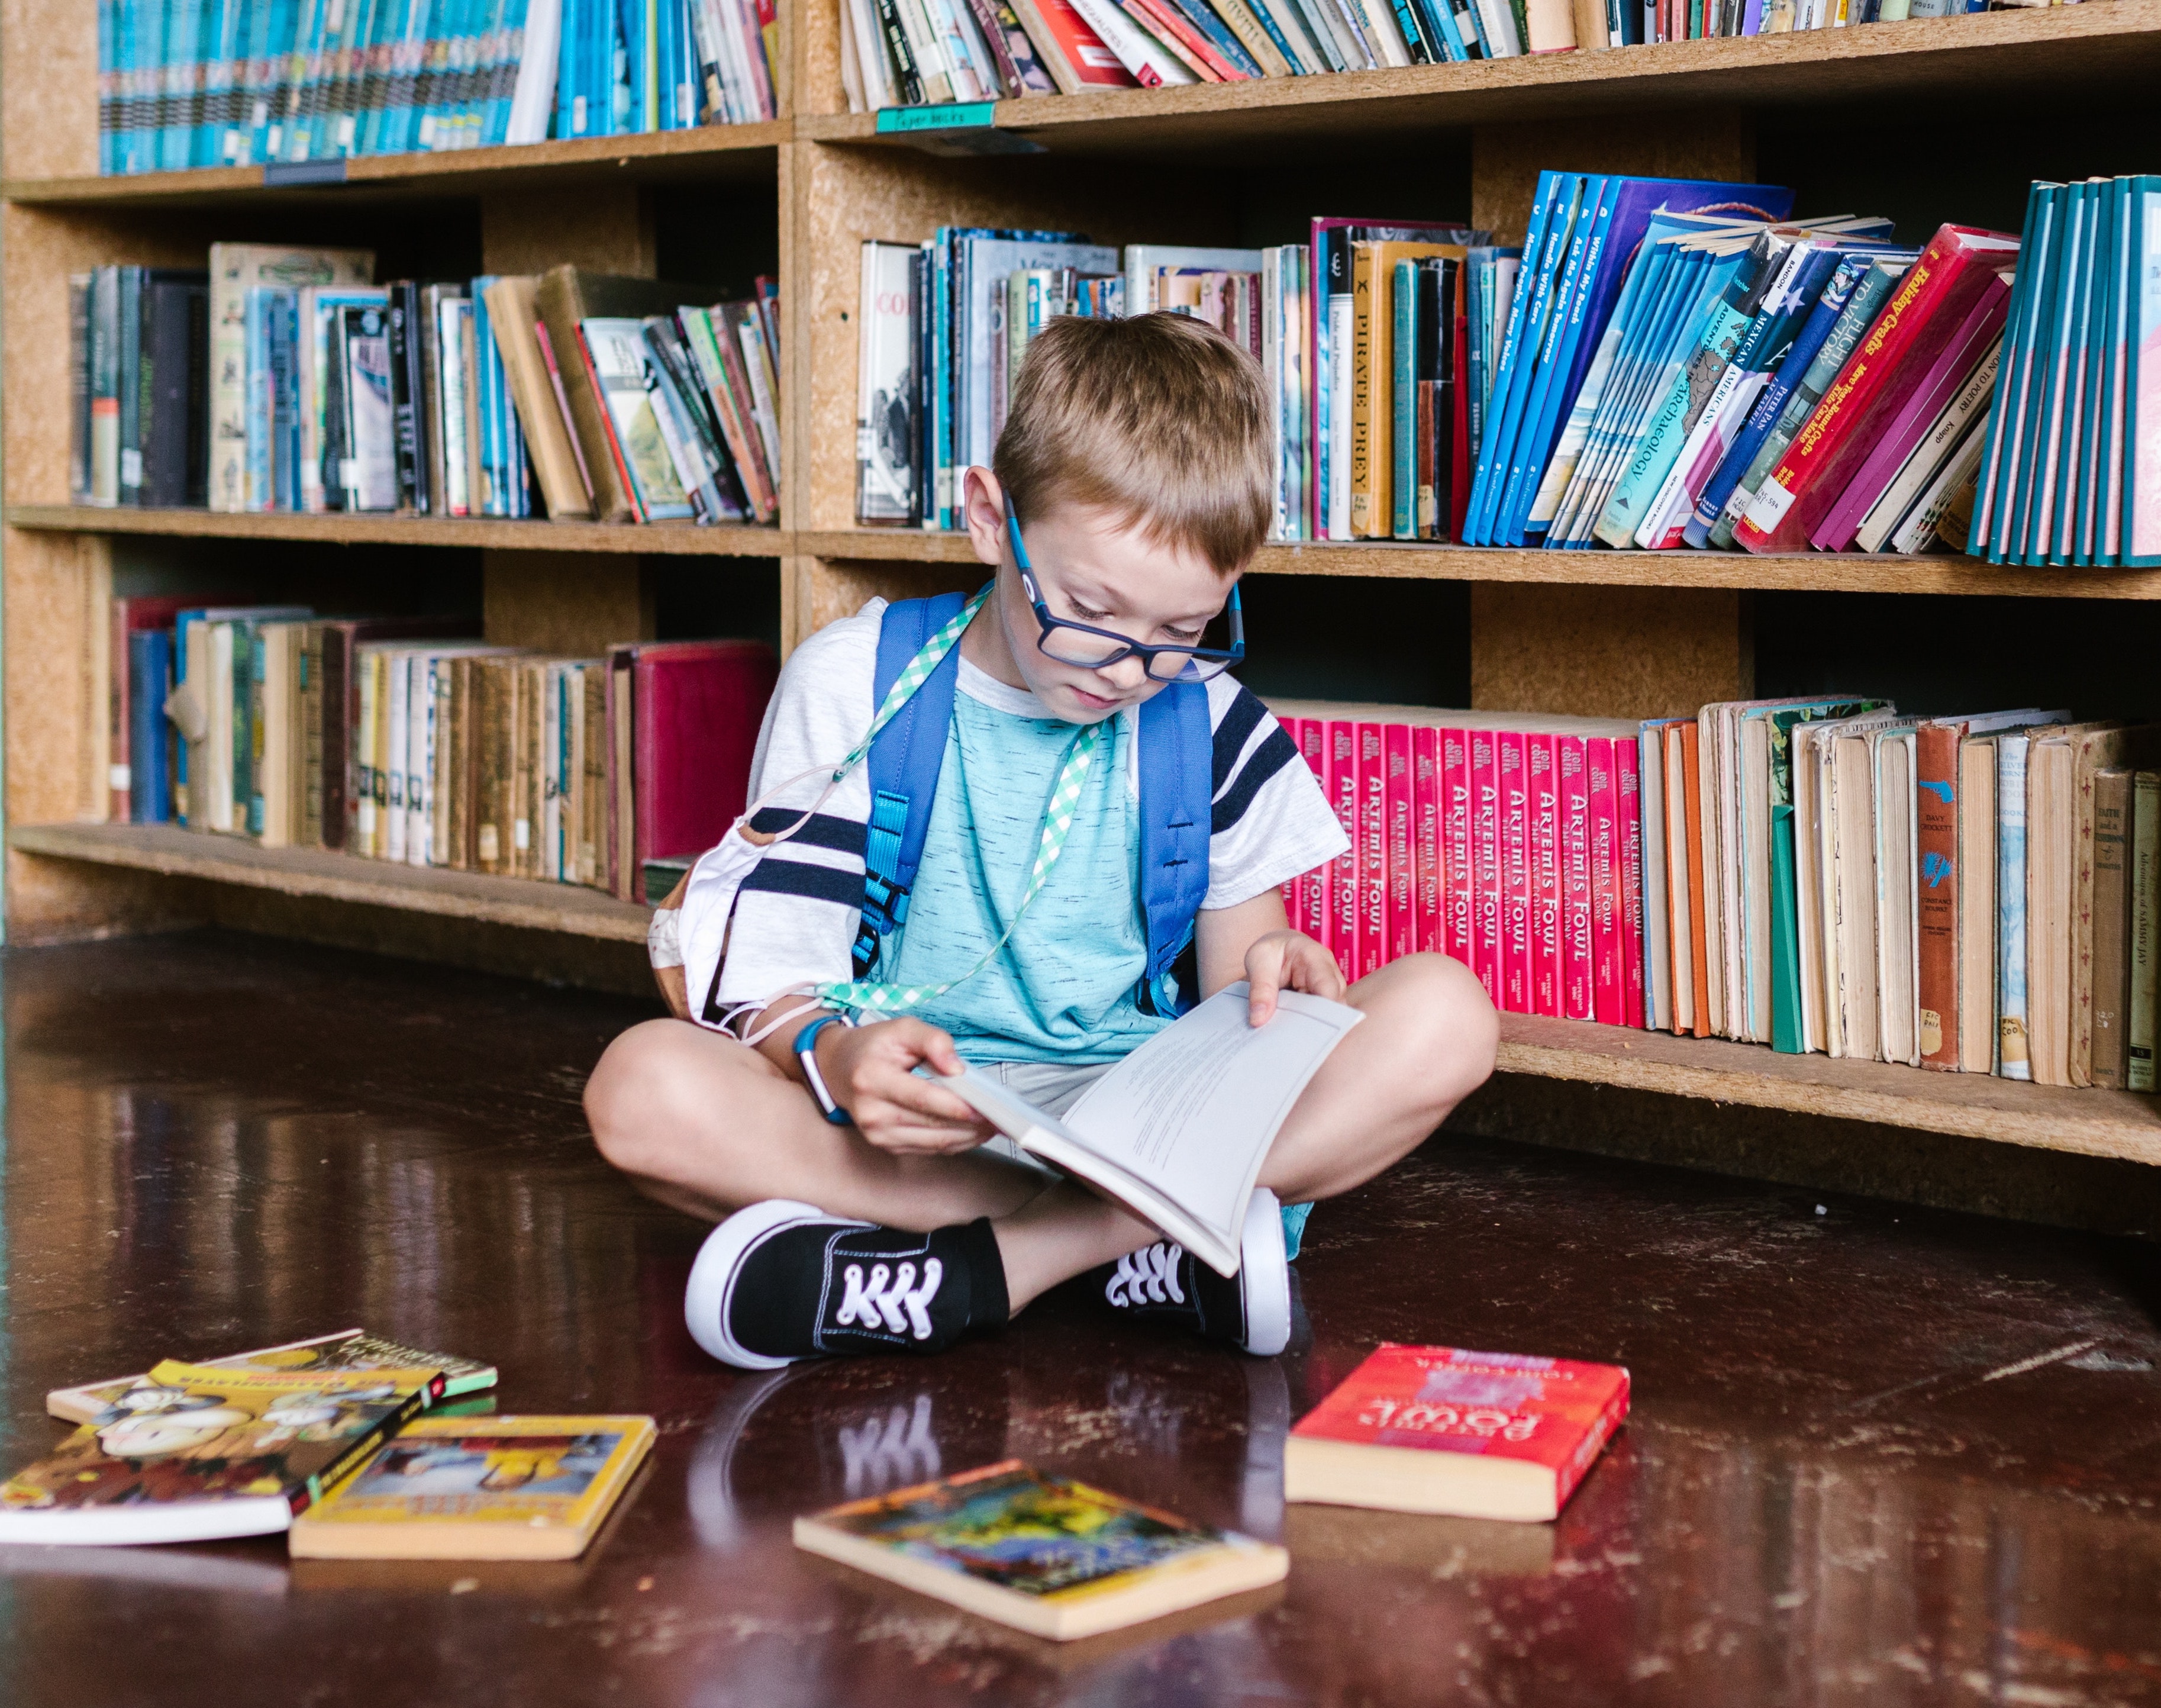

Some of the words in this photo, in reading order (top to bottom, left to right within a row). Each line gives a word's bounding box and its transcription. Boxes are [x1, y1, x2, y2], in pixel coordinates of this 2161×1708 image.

[1523, 232, 1535, 263] Many
[1544, 232, 1559, 269] Handle
[1572, 236, 1583, 257] Ask
[1585, 236, 1601, 272] Within
[1513, 265, 1528, 303] People,
[1537, 273, 1549, 298] With
[1566, 259, 1577, 276] Me
[1579, 273, 1590, 291] My
[1777, 260, 1795, 289] BANDON
[1557, 278, 1572, 310] Again
[1570, 292, 1585, 324] Reach
[1854, 280, 1873, 302] TO
[1867, 288, 1883, 309] Hough
[1891, 265, 1930, 315] Holiday
[1507, 307, 1519, 337] Many
[1531, 300, 1542, 325] Care
[1543, 312, 1563, 365] Tomorrow
[1691, 305, 1728, 373] ADVENTURES
[1737, 314, 1767, 365] MEXICAN
[1818, 303, 1859, 365] VICTORY
[1828, 318, 1865, 369] FLIGHT
[1865, 314, 1898, 356] Crafts
[1356, 314, 1369, 408] PIRATE
[1500, 339, 1512, 372] Voices
[1849, 363, 1868, 385] More
[1826, 384, 1843, 405] Kids
[1978, 369, 1990, 384] TO
[1702, 369, 1737, 427] AMERICANS
[1749, 394, 1769, 427] BARRIE
[1771, 386, 1788, 413] PETER
[1815, 404, 1829, 420] Can
[1818, 384, 1854, 433] Year-Round
[1960, 382, 1982, 414] POETRY
[1758, 413, 1773, 431] PAN
[1799, 420, 1818, 443] Make
[1936, 421, 1955, 444] Knapp
[1354, 422, 1367, 489] PREY
[1801, 430, 1822, 457] Crafts
[1656, 486, 1672, 514] DISCOVERY
[1735, 497, 1746, 507] FIC
[1758, 488, 1779, 510] 745.594
[1646, 513, 1657, 530] BOOKS
[1369, 776, 1384, 869] ARTEMIS
[1396, 800, 1408, 866] ARTEMIS
[1424, 803, 1437, 870] ARTEMIS
[1453, 785, 1469, 881] ARTEMIS
[1481, 785, 1497, 881] ARTEMIS
[1510, 789, 1526, 886] ARTEMIS
[1540, 791, 1556, 888] ARTEMIS
[1571, 794, 1588, 891] ARTEMIS
[1599, 817, 1612, 887] ARTEMIS
[1629, 820, 1641, 889] ARTEMIS
[1398, 872, 1409, 913] FOWL
[2139, 851, 2149, 896] Adventures
[1309, 874, 1324, 930] FOWL
[1341, 878, 1356, 934] FOWL
[1369, 878, 1384, 936] FOWL
[1426, 876, 1437, 916] FOWL
[1602, 892, 1614, 935] FOWL
[2139, 898, 2148, 908] of
[1455, 890, 1470, 948] FOWL
[1483, 890, 1499, 949] FOWL
[1512, 896, 1528, 955] FOWL
[1543, 898, 1558, 958] FOWL
[1573, 902, 1590, 962] FOWL
[1633, 895, 1644, 938] FOWL
[2139, 910, 2147, 947] SAMMY
[2137, 947, 2147, 966] JAY
